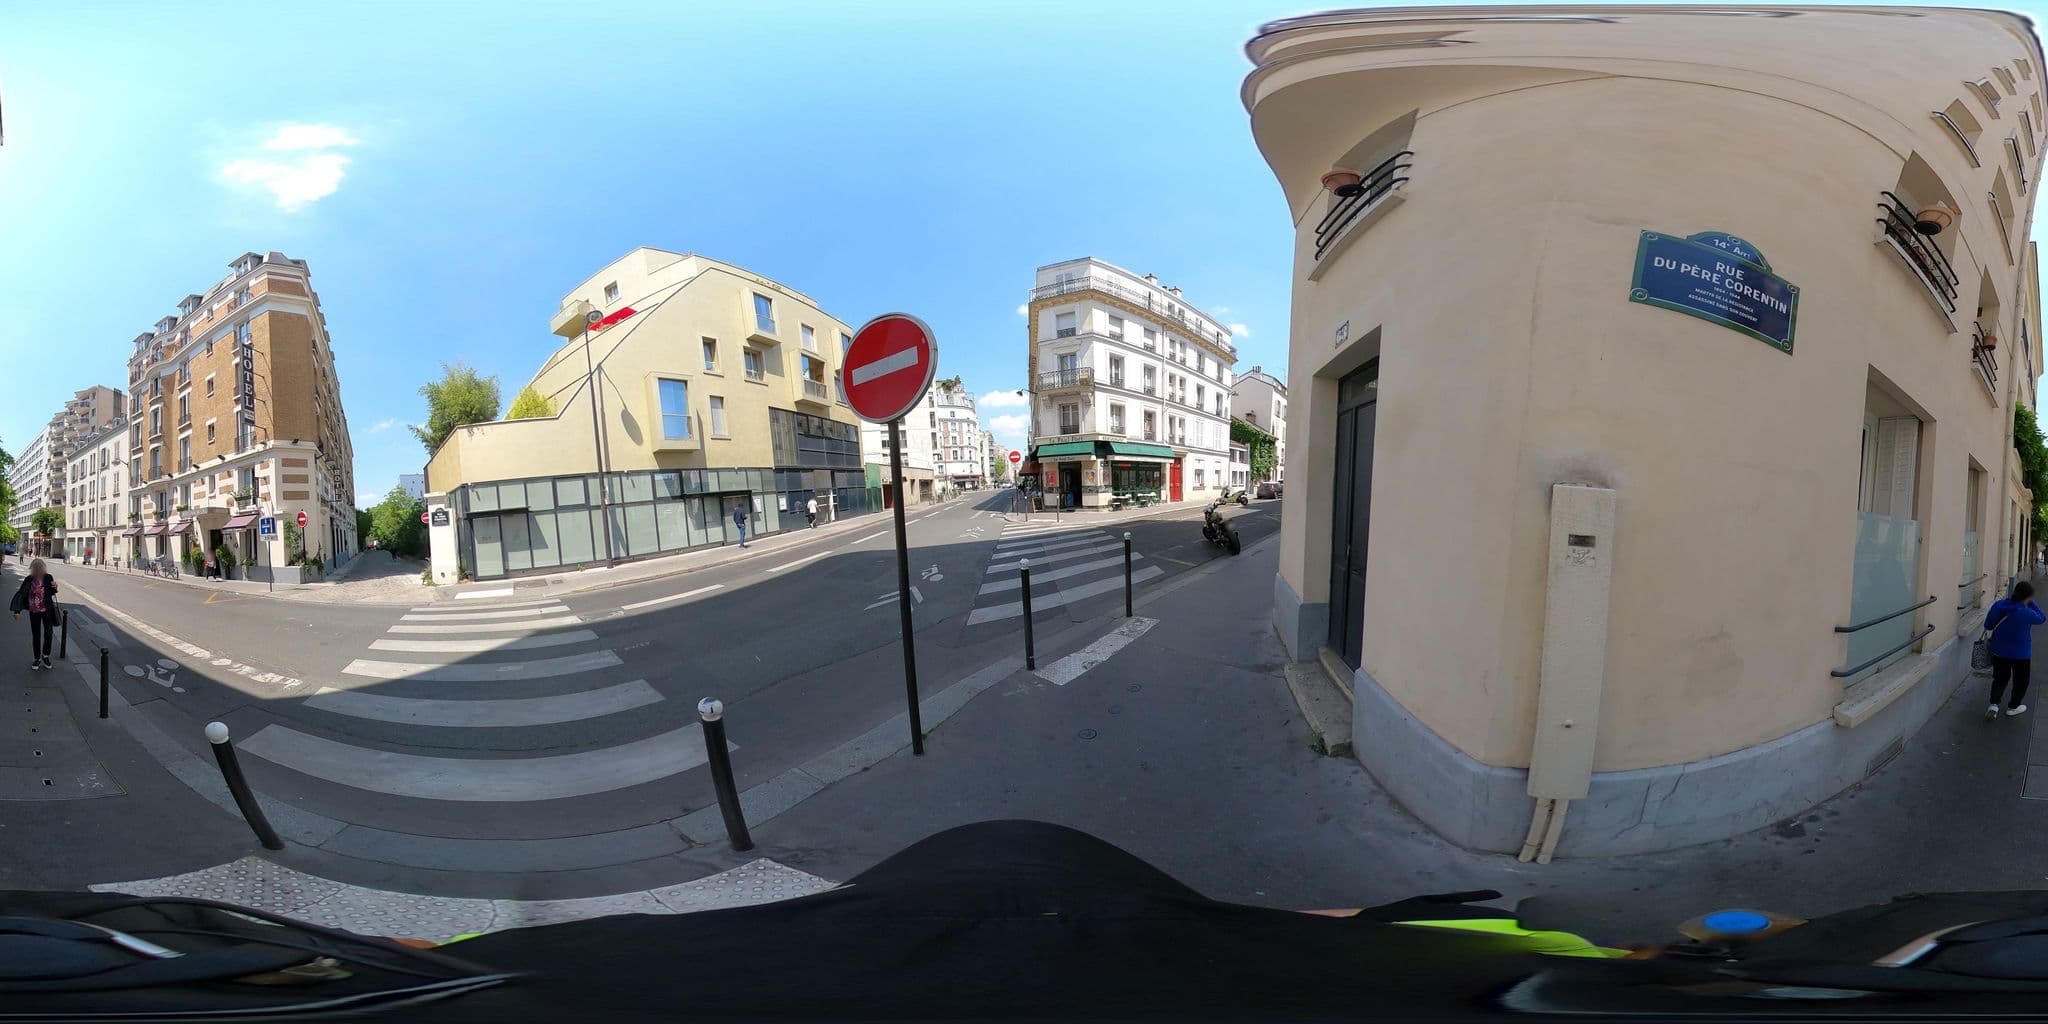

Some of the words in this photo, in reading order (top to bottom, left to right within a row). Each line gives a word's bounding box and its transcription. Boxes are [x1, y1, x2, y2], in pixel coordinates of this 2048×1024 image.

[1654, 256, 1677, 270] DU
[1680, 263, 1721, 285] PÈRE
[1725, 278, 1788, 314] CORENTIN
[1716, 262, 1745, 281] RUE
[244, 347, 253, 407] HOTEL
